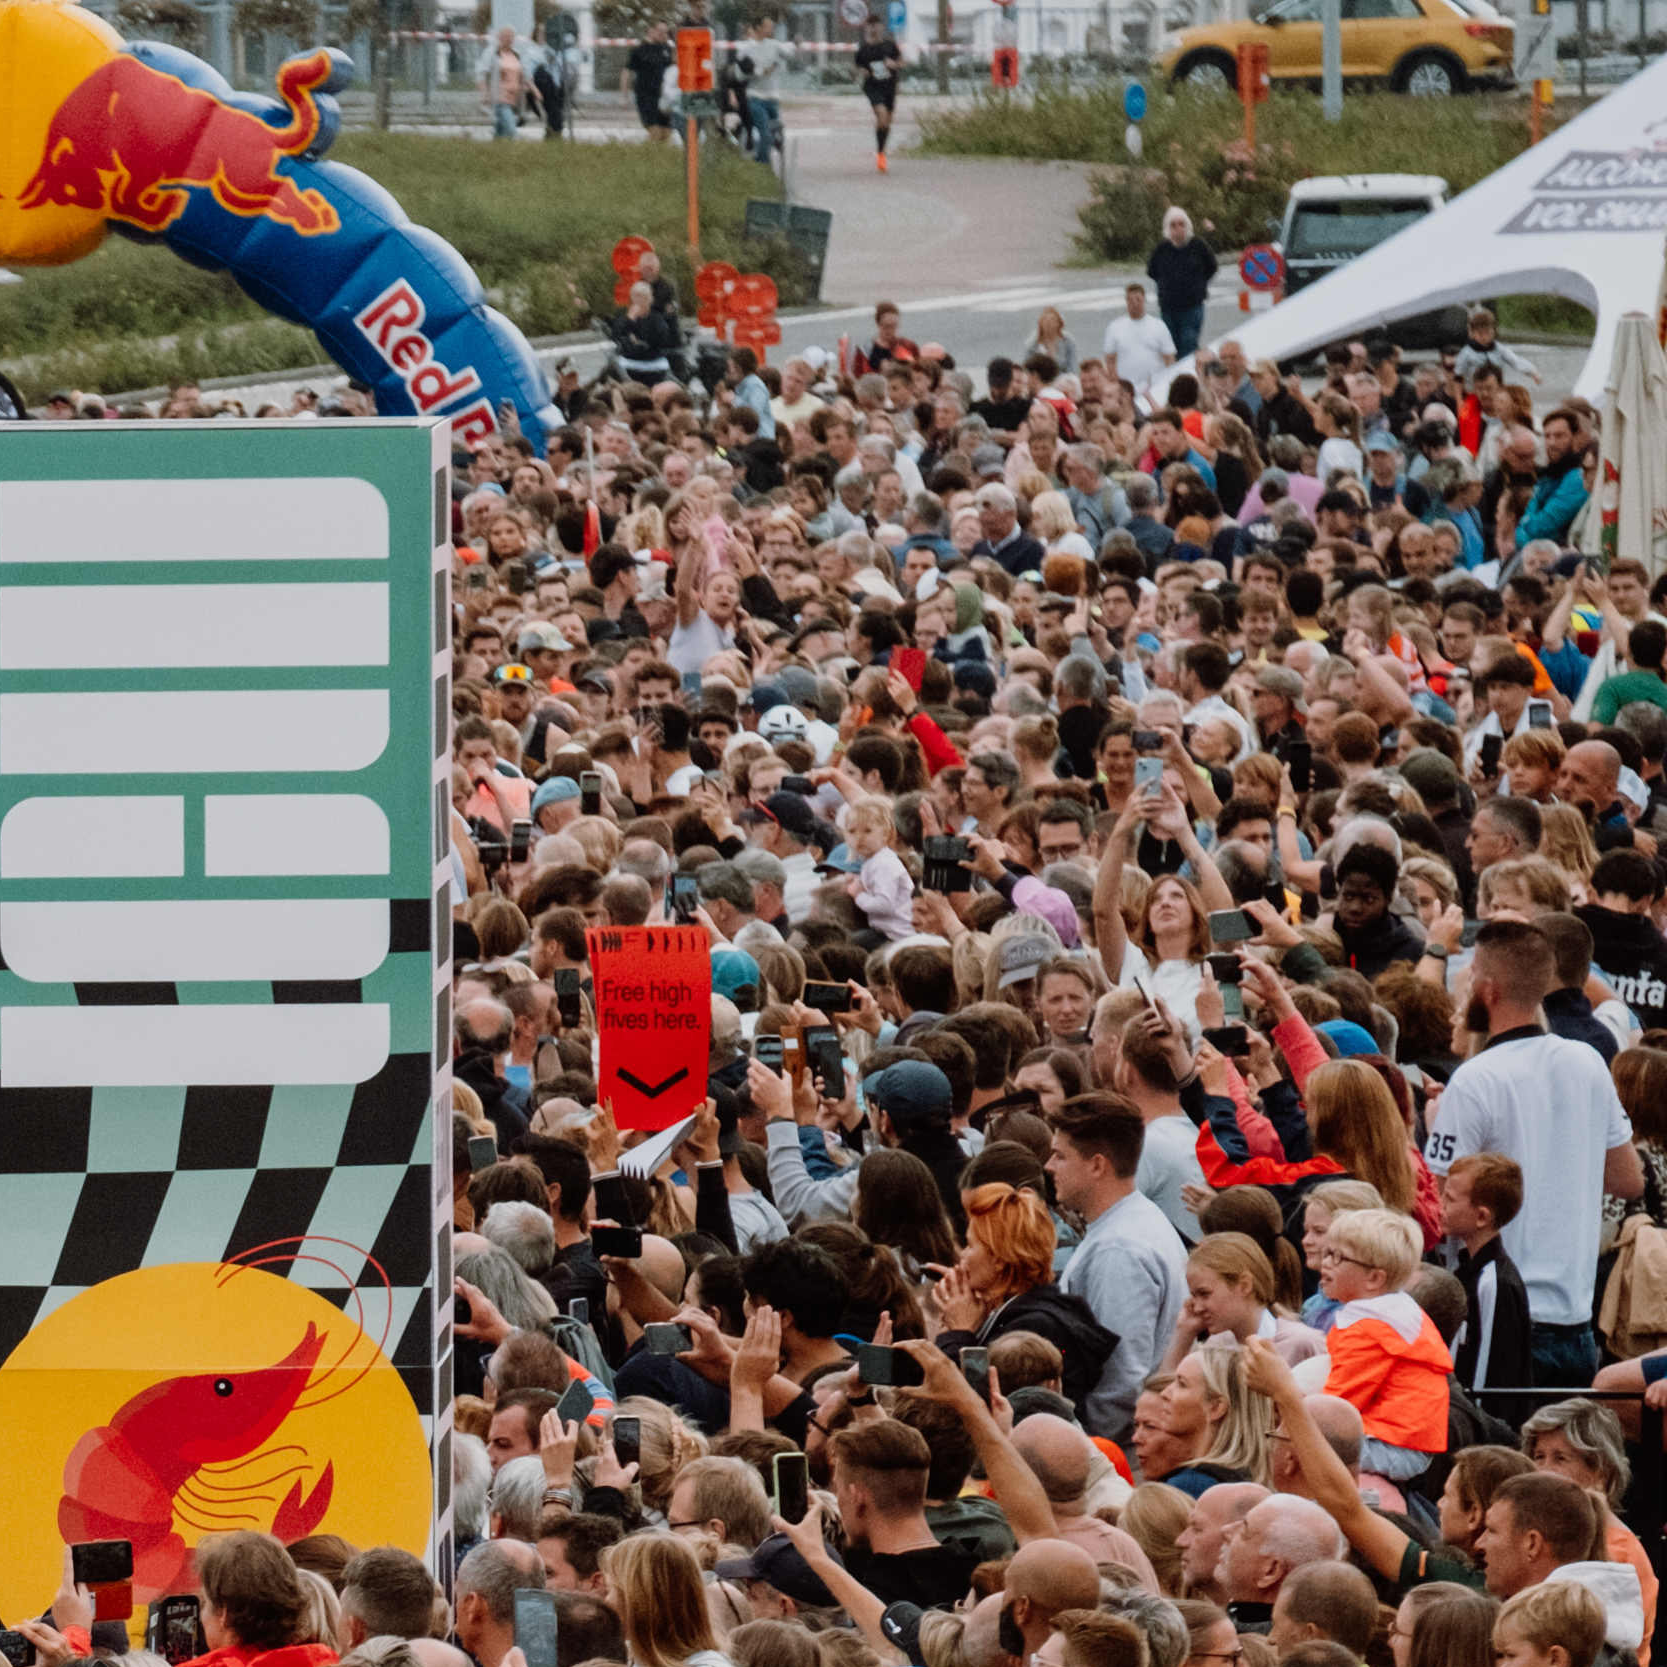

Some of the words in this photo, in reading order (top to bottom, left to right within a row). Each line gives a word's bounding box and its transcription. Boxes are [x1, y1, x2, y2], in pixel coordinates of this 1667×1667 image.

[357, 282, 481, 414] Red
[603, 981, 645, 1001] Free
[649, 980, 687, 1007] high
[604, 1008, 648, 1029] fives
[653, 1008, 702, 1029] here.
[1430, 1132, 1457, 1162] 35
